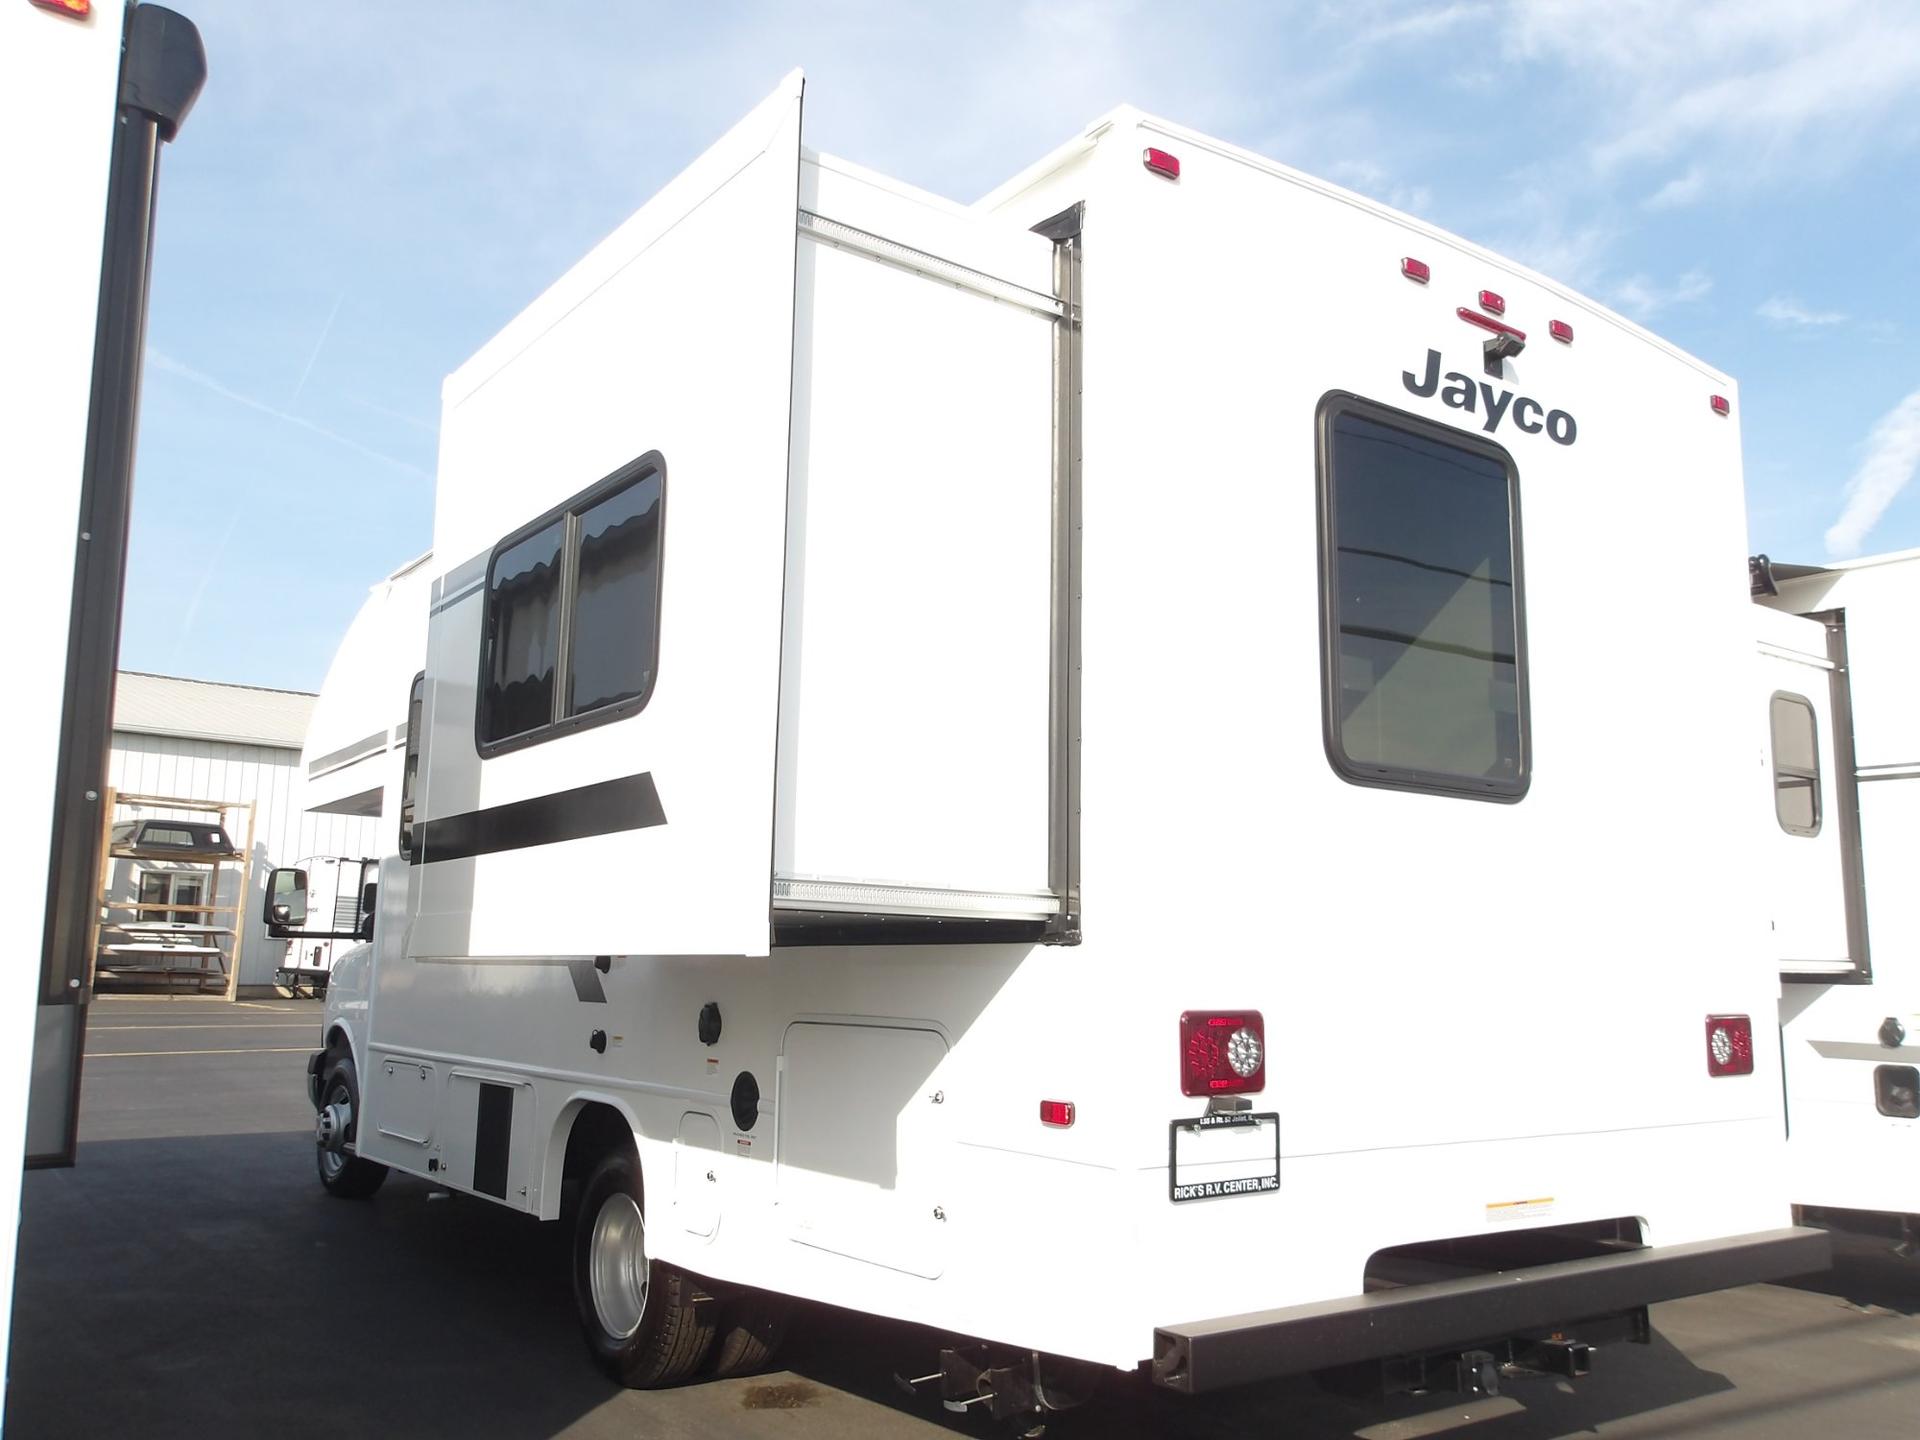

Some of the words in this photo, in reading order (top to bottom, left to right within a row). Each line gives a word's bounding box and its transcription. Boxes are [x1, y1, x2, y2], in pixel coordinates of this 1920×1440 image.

[1402, 348, 1577, 446] Jayco
[1174, 1185, 1204, 1199] RICK'S
[1205, 1182, 1222, 1195] R.V.
[1223, 1179, 1261, 1193] CENTER,
[1261, 1177, 1279, 1189] INC.
